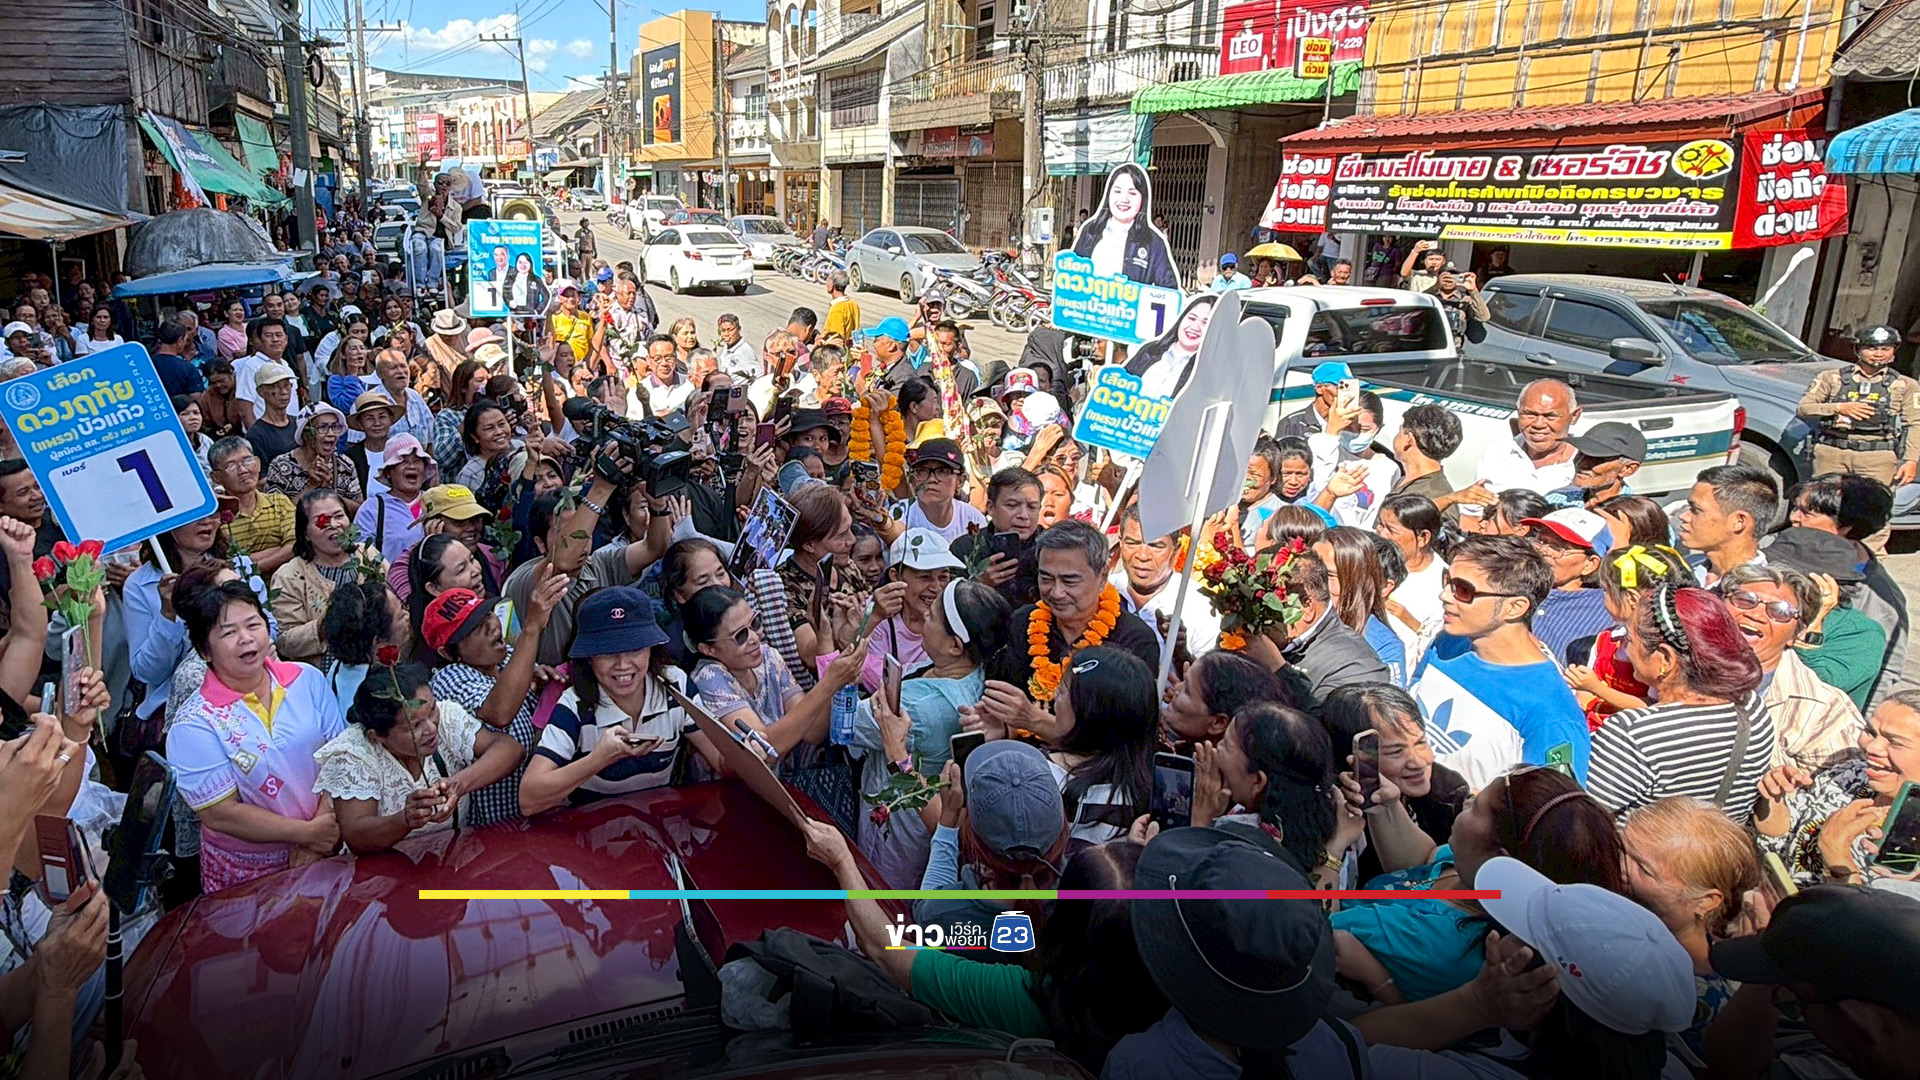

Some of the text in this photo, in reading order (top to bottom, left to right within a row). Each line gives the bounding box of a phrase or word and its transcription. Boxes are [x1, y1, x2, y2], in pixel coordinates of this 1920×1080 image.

[1233, 39, 1259, 55] LEO
[1762, 133, 1825, 166] ซ่อม
[1283, 154, 1331, 175] ซ่อม
[1494, 155, 1522, 180] &
[1388, 181, 1724, 200] รับซ่อมโทรศัพท์มือถือครบวงจร
[1757, 169, 1827, 202] มือถือ
[1058, 257, 1091, 273] เลือก
[488, 288, 497, 306] 1
[1056, 273, 1139, 302] ดวงฤทัย
[1088, 296, 1136, 320] บัวแก้ว
[1150, 302, 1166, 337] 1
[47, 366, 96, 392] เลือก
[124, 353, 161, 421] DEMOCRAT
[1101, 373, 1138, 393] เลือก
[17, 380, 135, 434] ดวงฤทัย
[146, 379, 170, 419] PARTY
[1094, 387, 1172, 422] ดวงฤทั
[31, 428, 79, 454] (แพรว)
[78, 402, 145, 436] บัวแก้ว
[49, 445, 83, 462] ผู้สมัคร
[84, 438, 101, 449] สส.
[138, 421, 146, 430] 2
[62, 461, 86, 476] เบอร์
[116, 449, 174, 513] 1
[438, 592, 475, 622] MISS
